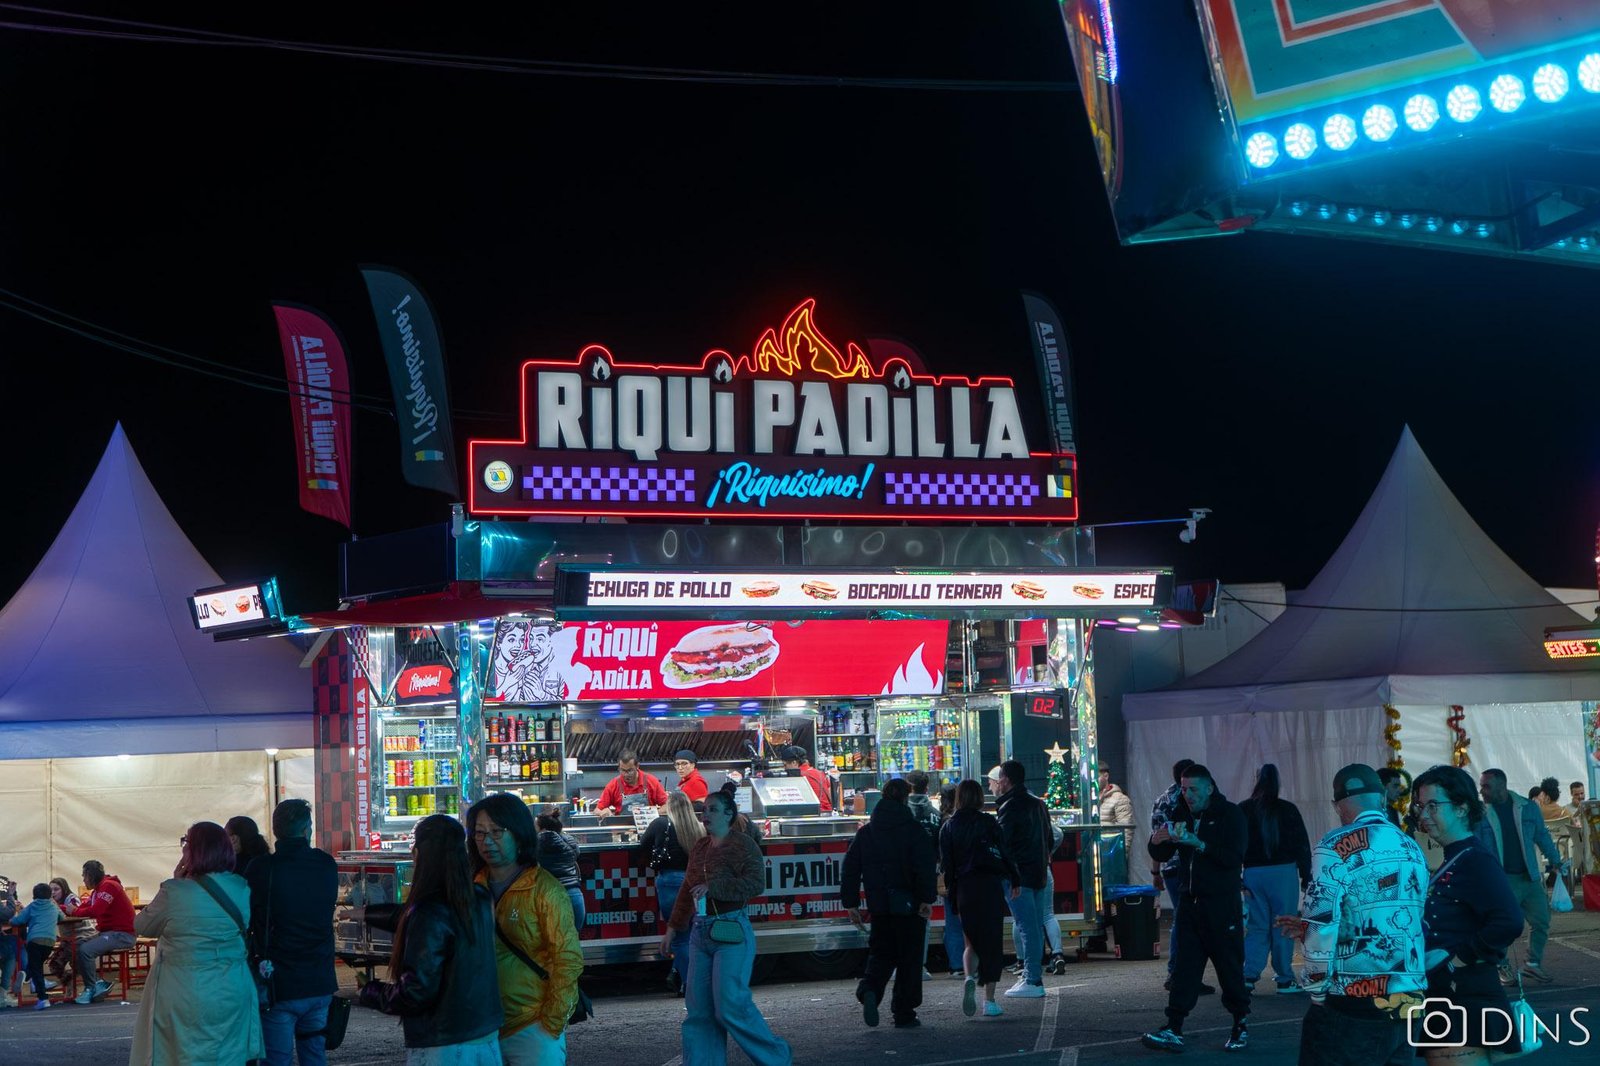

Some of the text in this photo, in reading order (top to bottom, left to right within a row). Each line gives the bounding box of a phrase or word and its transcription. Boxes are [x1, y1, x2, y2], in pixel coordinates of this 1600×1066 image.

[706, 461, 875, 508] ¡Riquísimo!
[653, 581, 674, 598] DE
[679, 581, 732, 598] POLLO
[847, 583, 1003, 600] BOCADILLO TERNERA
[1033, 698, 1054, 714] 02
[586, 911, 637, 925] REFRESCOS
